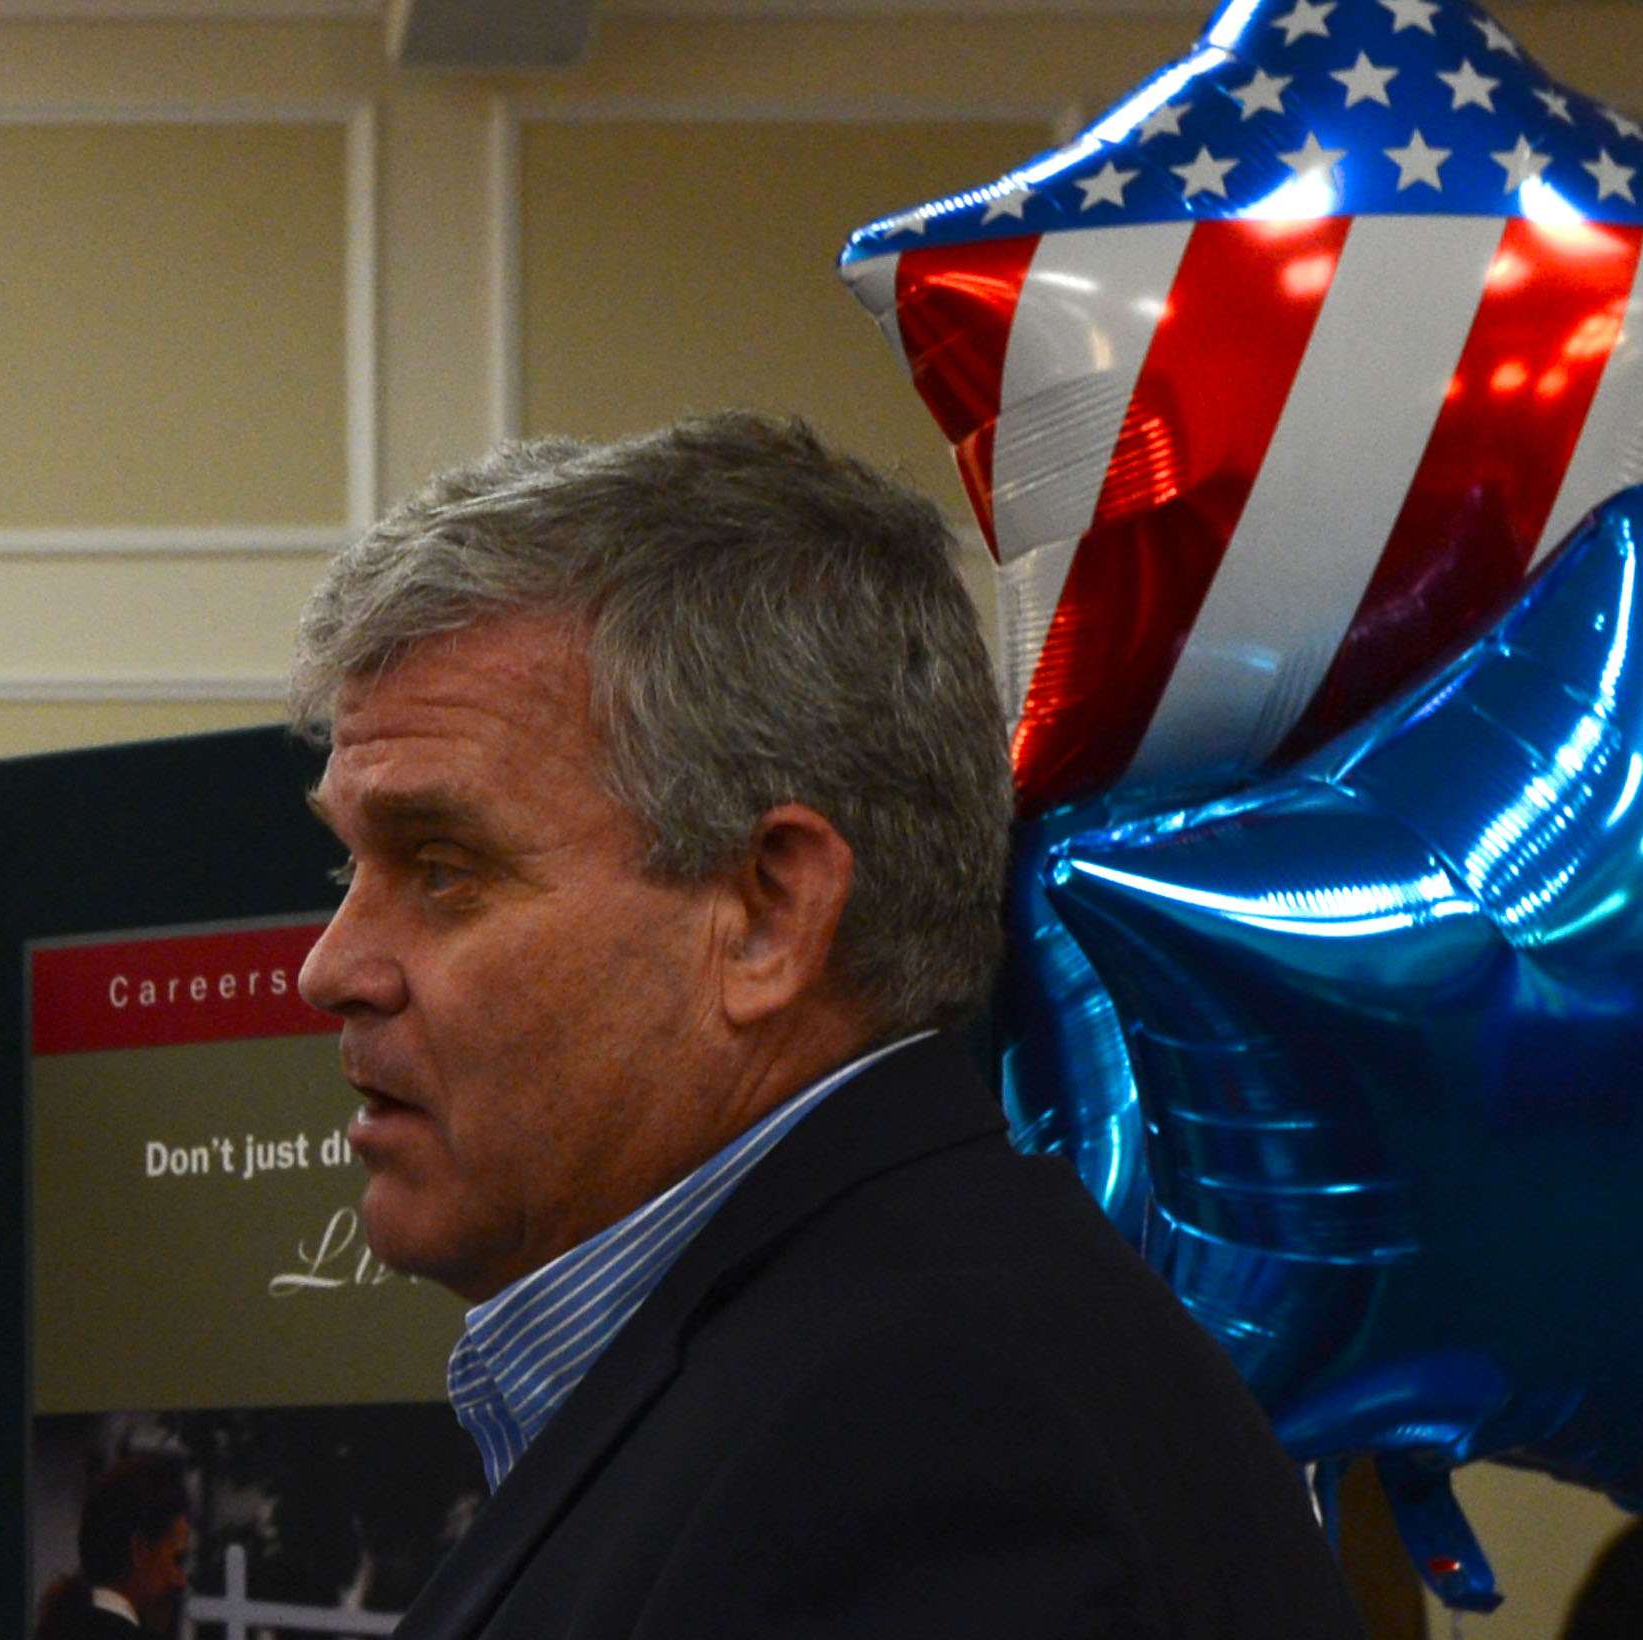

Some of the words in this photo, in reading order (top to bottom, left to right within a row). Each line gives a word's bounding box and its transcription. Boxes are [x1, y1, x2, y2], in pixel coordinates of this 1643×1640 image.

[109, 966, 288, 1010] Careers
[145, 1137, 234, 1178] Don't
[242, 1133, 310, 1181] just
